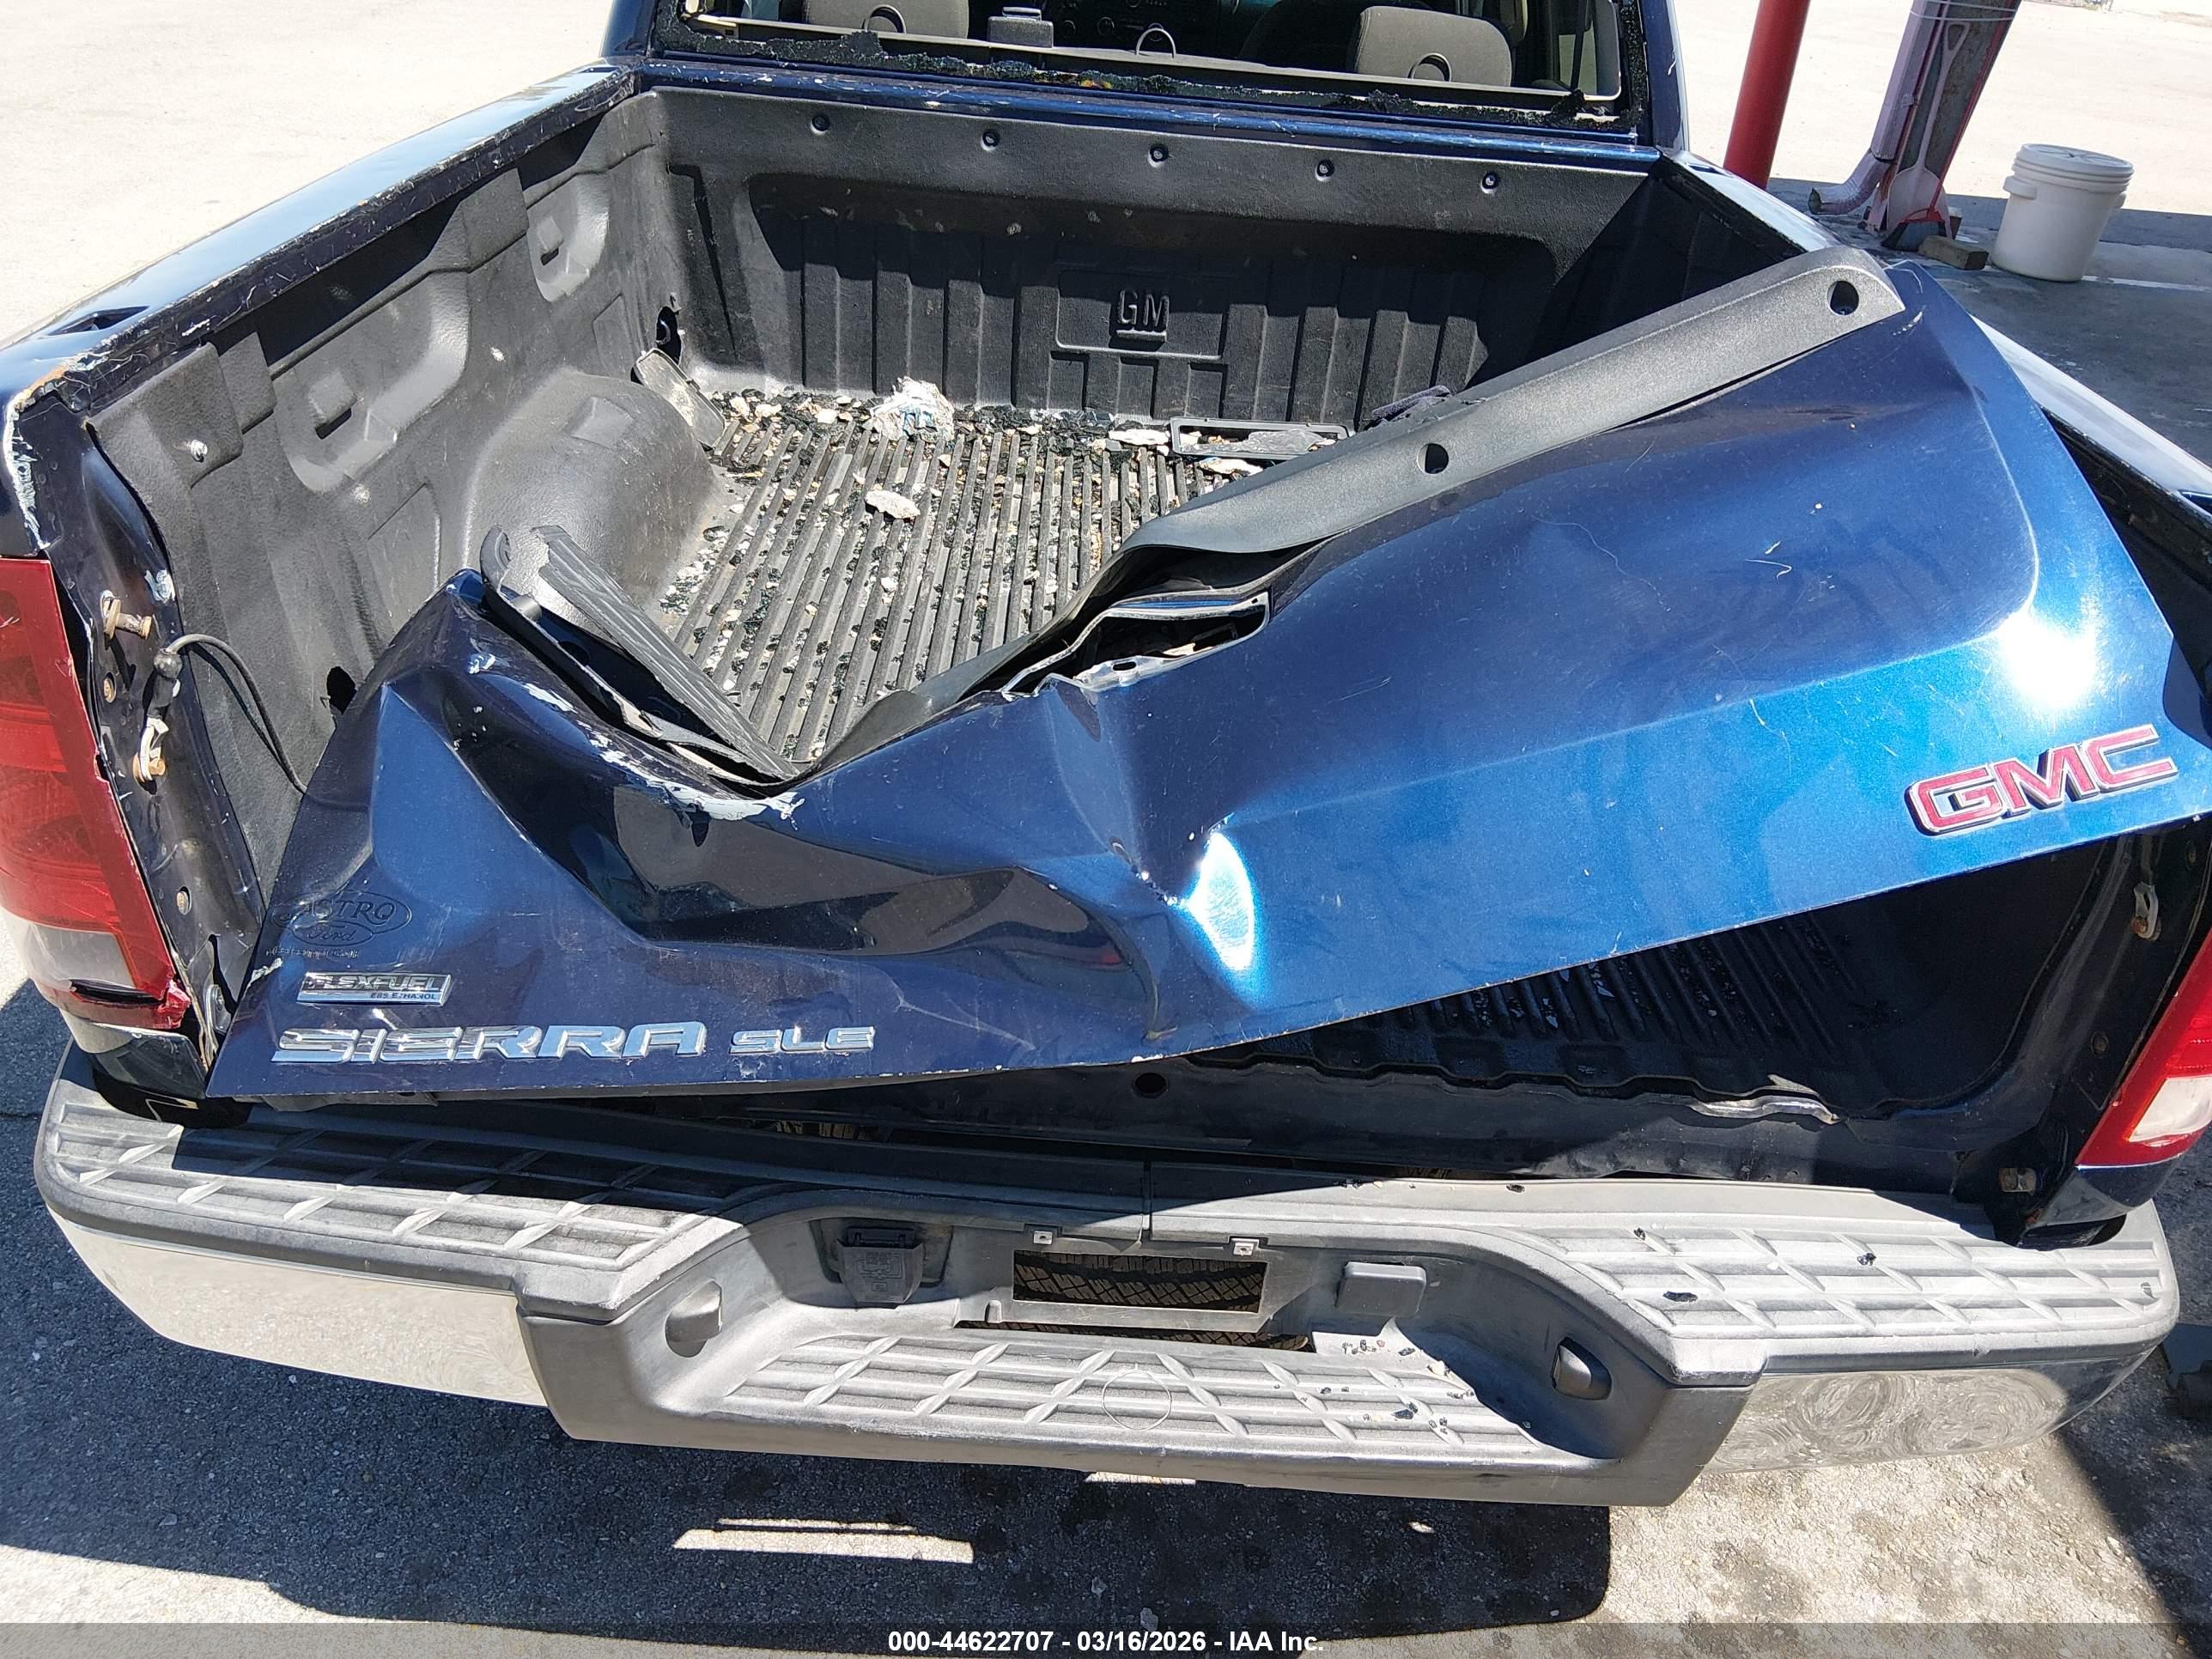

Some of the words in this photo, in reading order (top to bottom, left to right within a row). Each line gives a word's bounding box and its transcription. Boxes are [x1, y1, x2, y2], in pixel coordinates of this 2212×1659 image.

[1117, 289, 1170, 327] GM
[1904, 723, 2179, 836] GMC
[307, 922, 359, 942] Ford
[270, 1021, 708, 1063] SIERRA
[729, 1025, 876, 1055] SLE
